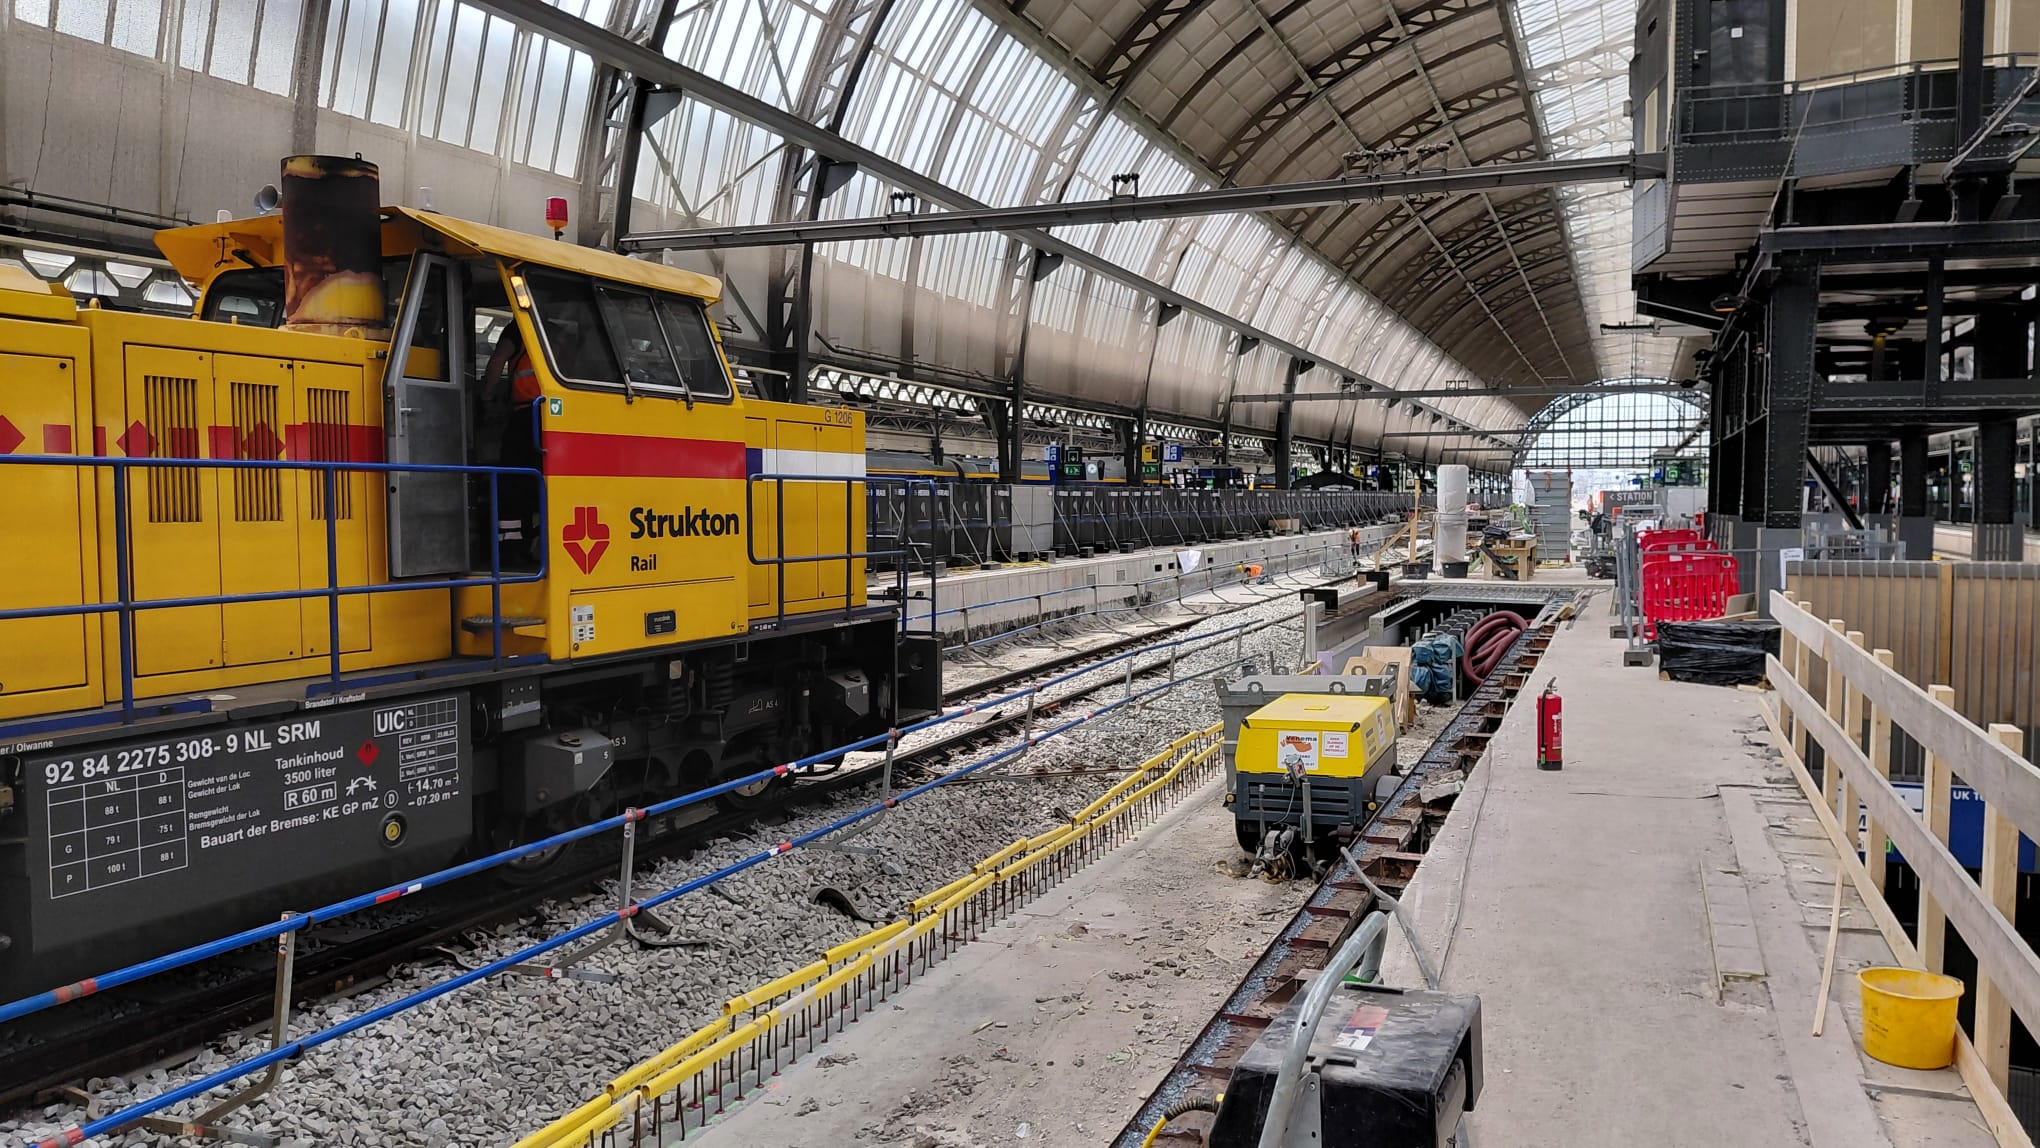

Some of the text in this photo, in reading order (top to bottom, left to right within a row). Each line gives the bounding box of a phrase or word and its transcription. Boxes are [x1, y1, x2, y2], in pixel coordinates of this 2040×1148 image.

[825, 409, 853, 425] G 1206
[1616, 492, 1653, 502] STATION
[629, 506, 739, 539] Strukton
[631, 553, 657, 571] Rail
[377, 710, 406, 733] UIC
[45, 761, 74, 785] 92
[82, 755, 110, 778] 84
[117, 745, 170, 773] 2275
[226, 734, 238, 753] 9
[245, 729, 272, 752] NL
[277, 720, 321, 744] SRM
[275, 746, 344, 770] Tankinhoud
[159, 772, 167, 783] D
[188, 770, 250, 788] Gewicht van de Loc
[284, 767, 337, 785] 3500 liter
[105, 781, 121, 793] NL
[188, 783, 240, 799] Gewicht der Lok
[416, 778, 443, 793] 14.70
[288, 787, 333, 807] R 60 m
[388, 793, 395, 805] D
[416, 792, 450, 806] 07.20 m
[1953, 790, 1970, 801] UK
[105, 806, 115, 816] 88
[188, 806, 229, 820] Remgewicht
[189, 809, 260, 831] Bremsgewicht der Lok
[201, 797, 379, 848] Bauart der Bremse: KE GP mZ
[159, 825, 168, 834] 75
[106, 836, 115, 845] 79
[65, 845, 72, 854] G
[107, 864, 121, 873] 100
[66, 875, 73, 883] P
